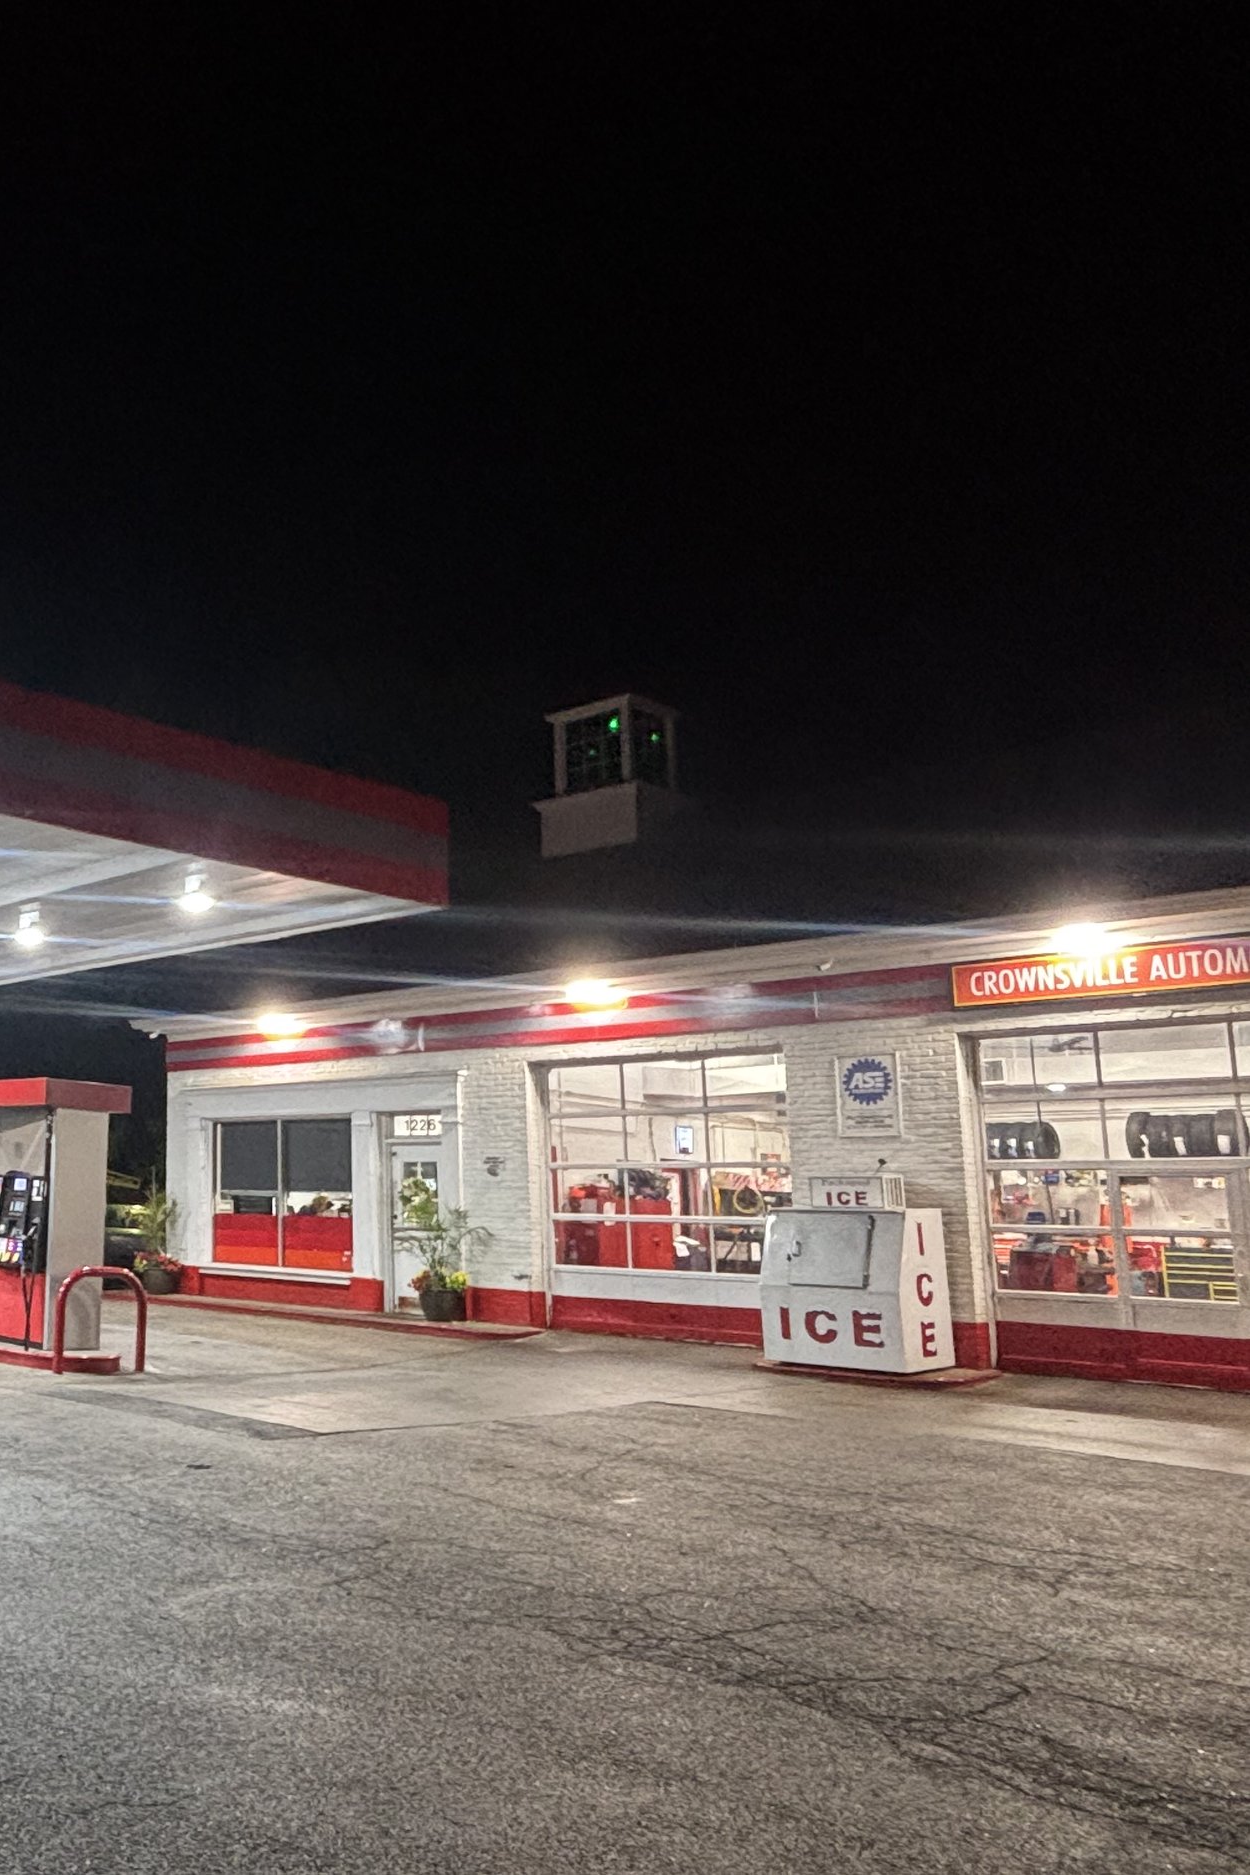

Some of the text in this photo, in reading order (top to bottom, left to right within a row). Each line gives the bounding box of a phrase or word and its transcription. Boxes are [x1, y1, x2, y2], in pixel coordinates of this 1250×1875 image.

[969, 946, 1250, 997] CROWNSVILLE AUTOM
[849, 1072, 885, 1089] ASE
[405, 1119, 436, 1131] 1226
[825, 1190, 869, 1207] ICE
[915, 1222, 938, 1357] ICE
[779, 1306, 886, 1348] ICE
